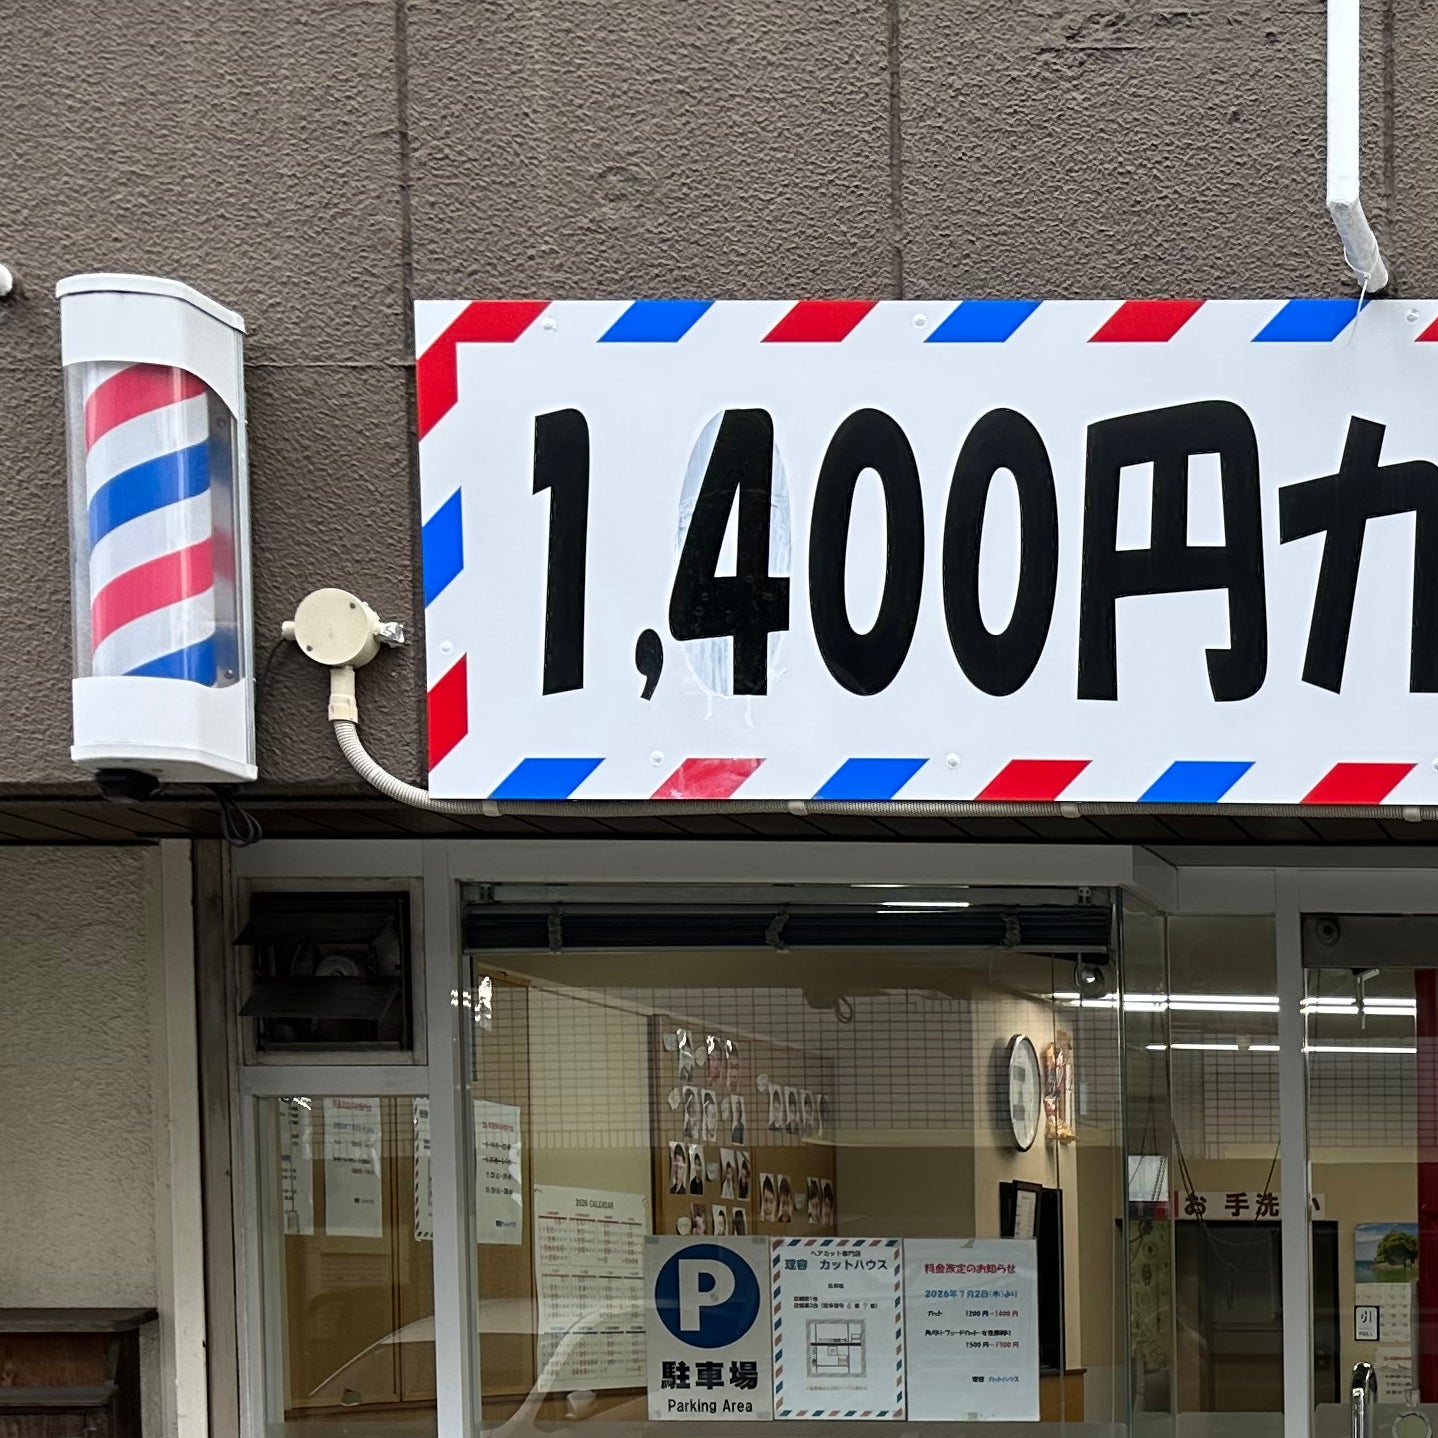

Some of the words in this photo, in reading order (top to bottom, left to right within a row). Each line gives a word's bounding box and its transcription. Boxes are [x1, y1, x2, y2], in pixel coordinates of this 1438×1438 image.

[924, 1263, 1016, 1275] 料金改定のお知らせ
[678, 1258, 735, 1331] P
[661, 1360, 758, 1390] 駐車場
[667, 1399, 717, 1414] Parking
[722, 1399, 753, 1413] Area
